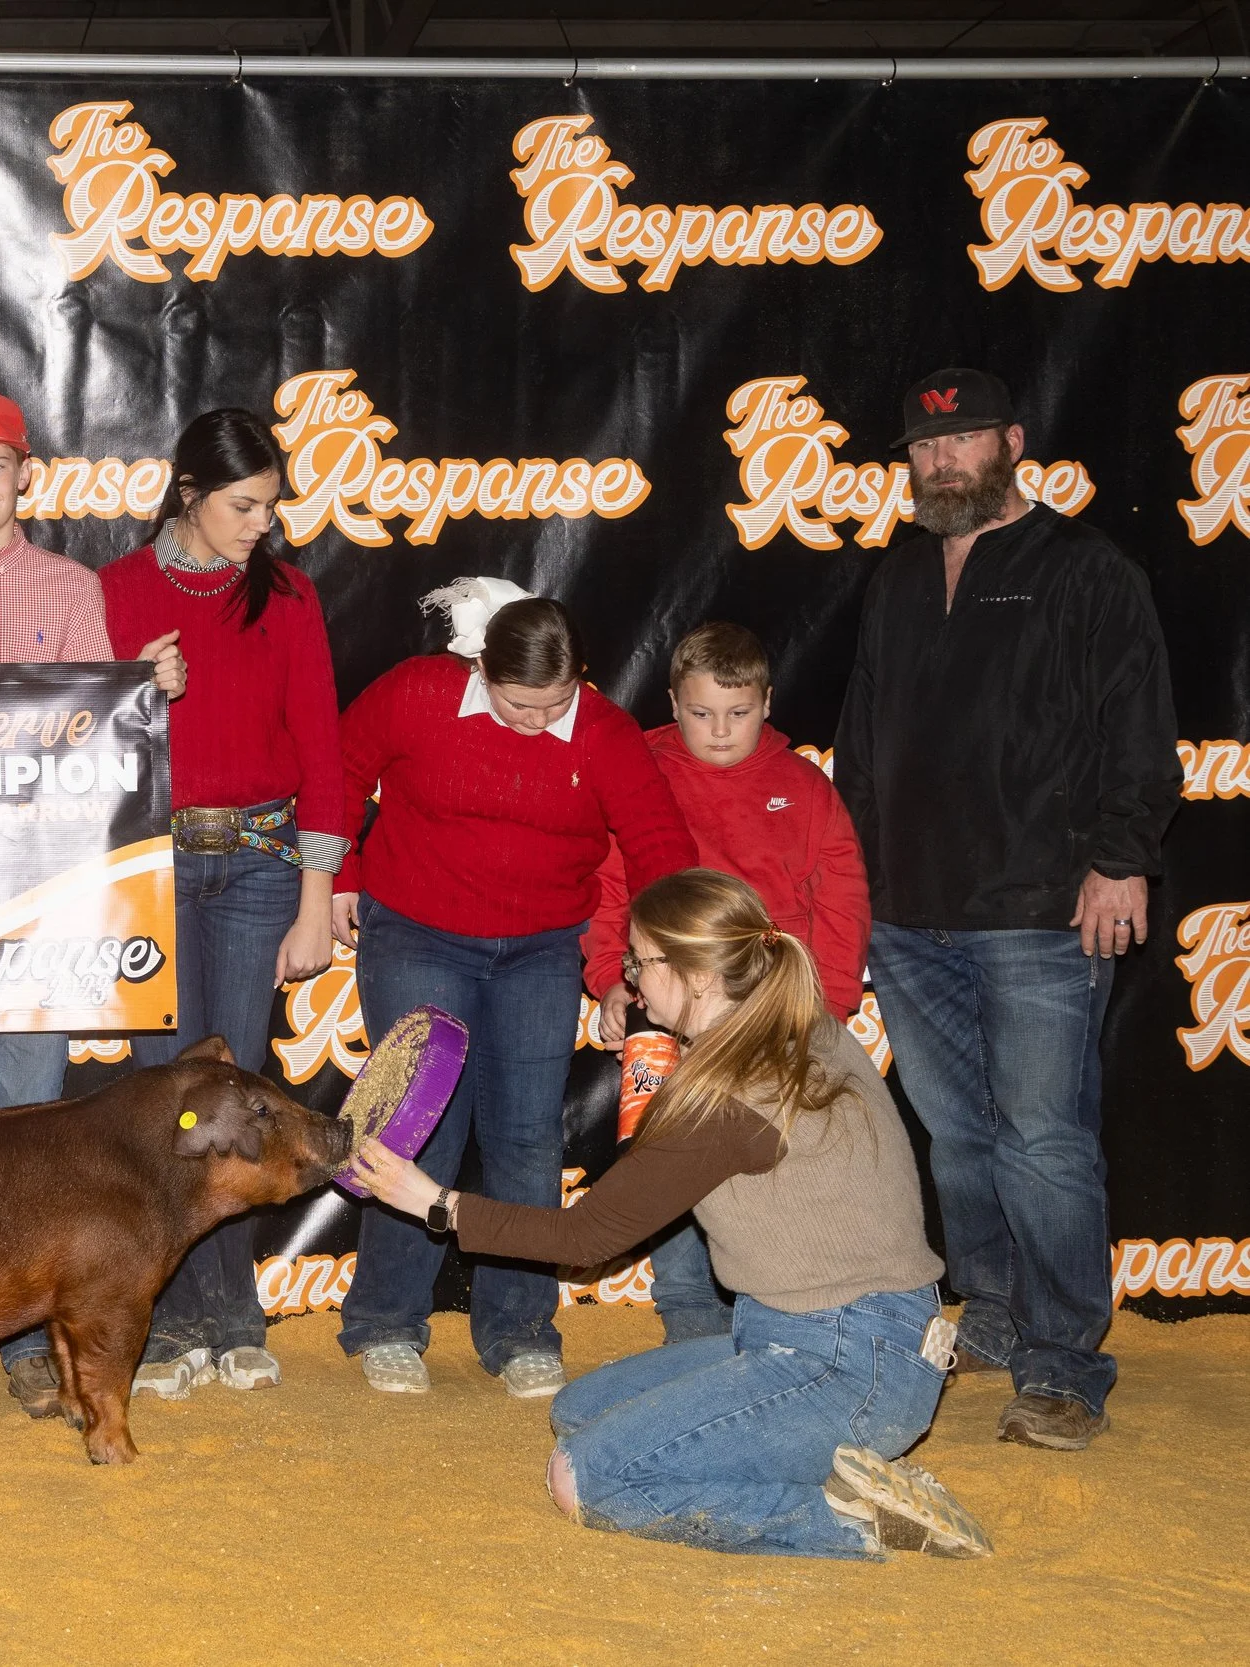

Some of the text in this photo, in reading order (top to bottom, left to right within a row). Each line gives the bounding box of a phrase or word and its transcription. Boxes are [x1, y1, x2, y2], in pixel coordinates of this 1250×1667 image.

[53, 104, 143, 178] The
[515, 118, 603, 190] The
[970, 120, 1058, 192] The
[55, 154, 428, 275] Response
[516, 166, 877, 286] Response
[974, 167, 1250, 285] Respon
[277, 373, 367, 445] The
[729, 380, 818, 450] The
[280, 421, 645, 539] Response
[733, 425, 1091, 543] Respse
[770, 797, 787, 806] NIKE
